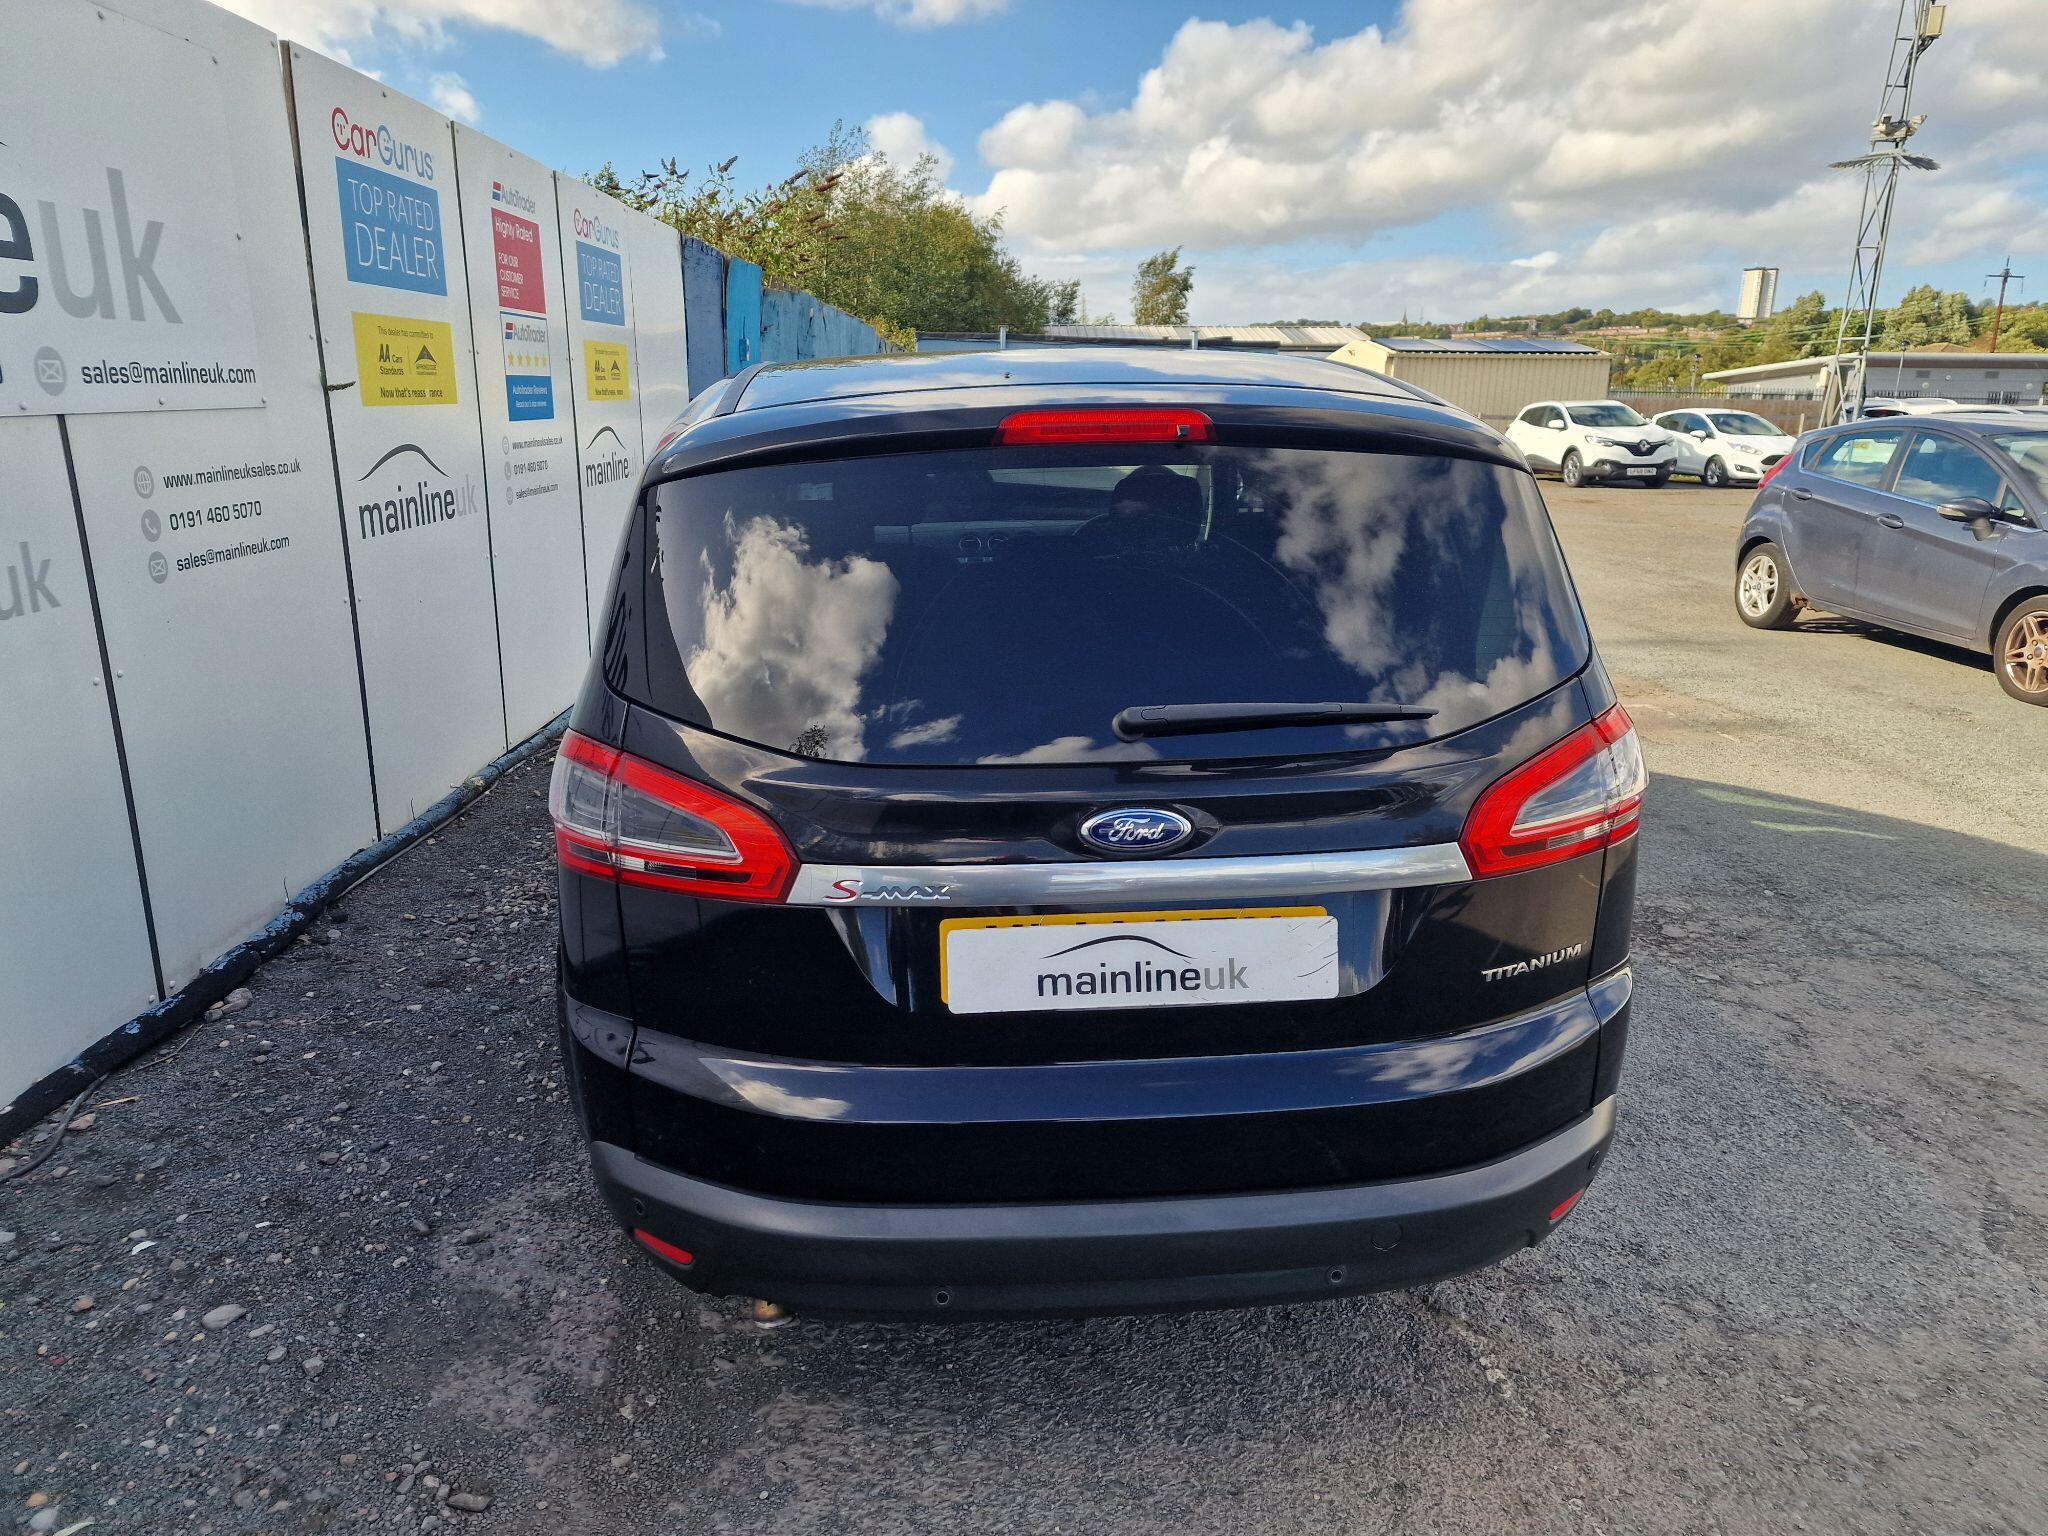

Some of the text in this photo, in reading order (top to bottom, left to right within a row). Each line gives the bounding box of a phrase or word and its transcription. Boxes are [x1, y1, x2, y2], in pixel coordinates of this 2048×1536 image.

[331, 107, 434, 181] CarGurus
[347, 178, 434, 232] TOP RATED
[501, 184, 536, 214] AutoTrader
[495, 217, 533, 242] Highly Rated
[573, 208, 620, 249] CarGurus
[354, 222, 439, 279] DEALER
[499, 269, 524, 285] CUSTOMER
[580, 253, 619, 283] TOP RATED
[584, 281, 622, 315] DEALER
[513, 324, 546, 343] AutoTrader
[379, 343, 391, 362] AA
[81, 359, 257, 385] sales@mainlineuk.com
[380, 387, 394, 398] Now
[395, 386, 411, 398] that's
[162, 458, 302, 489] www.mainlineuksales.co.uk
[513, 463, 526, 475] 0191
[537, 459, 549, 471] 5070
[169, 500, 262, 531] 0191 460 5070
[359, 474, 478, 540] mainlineuk
[176, 536, 290, 572] sales@mainlineuk.com
[1108, 817, 1164, 842] Ford
[822, 879, 951, 902] S-MAX
[1037, 957, 1250, 998] mainlineuk
[1481, 943, 1583, 983] TITANIUM
